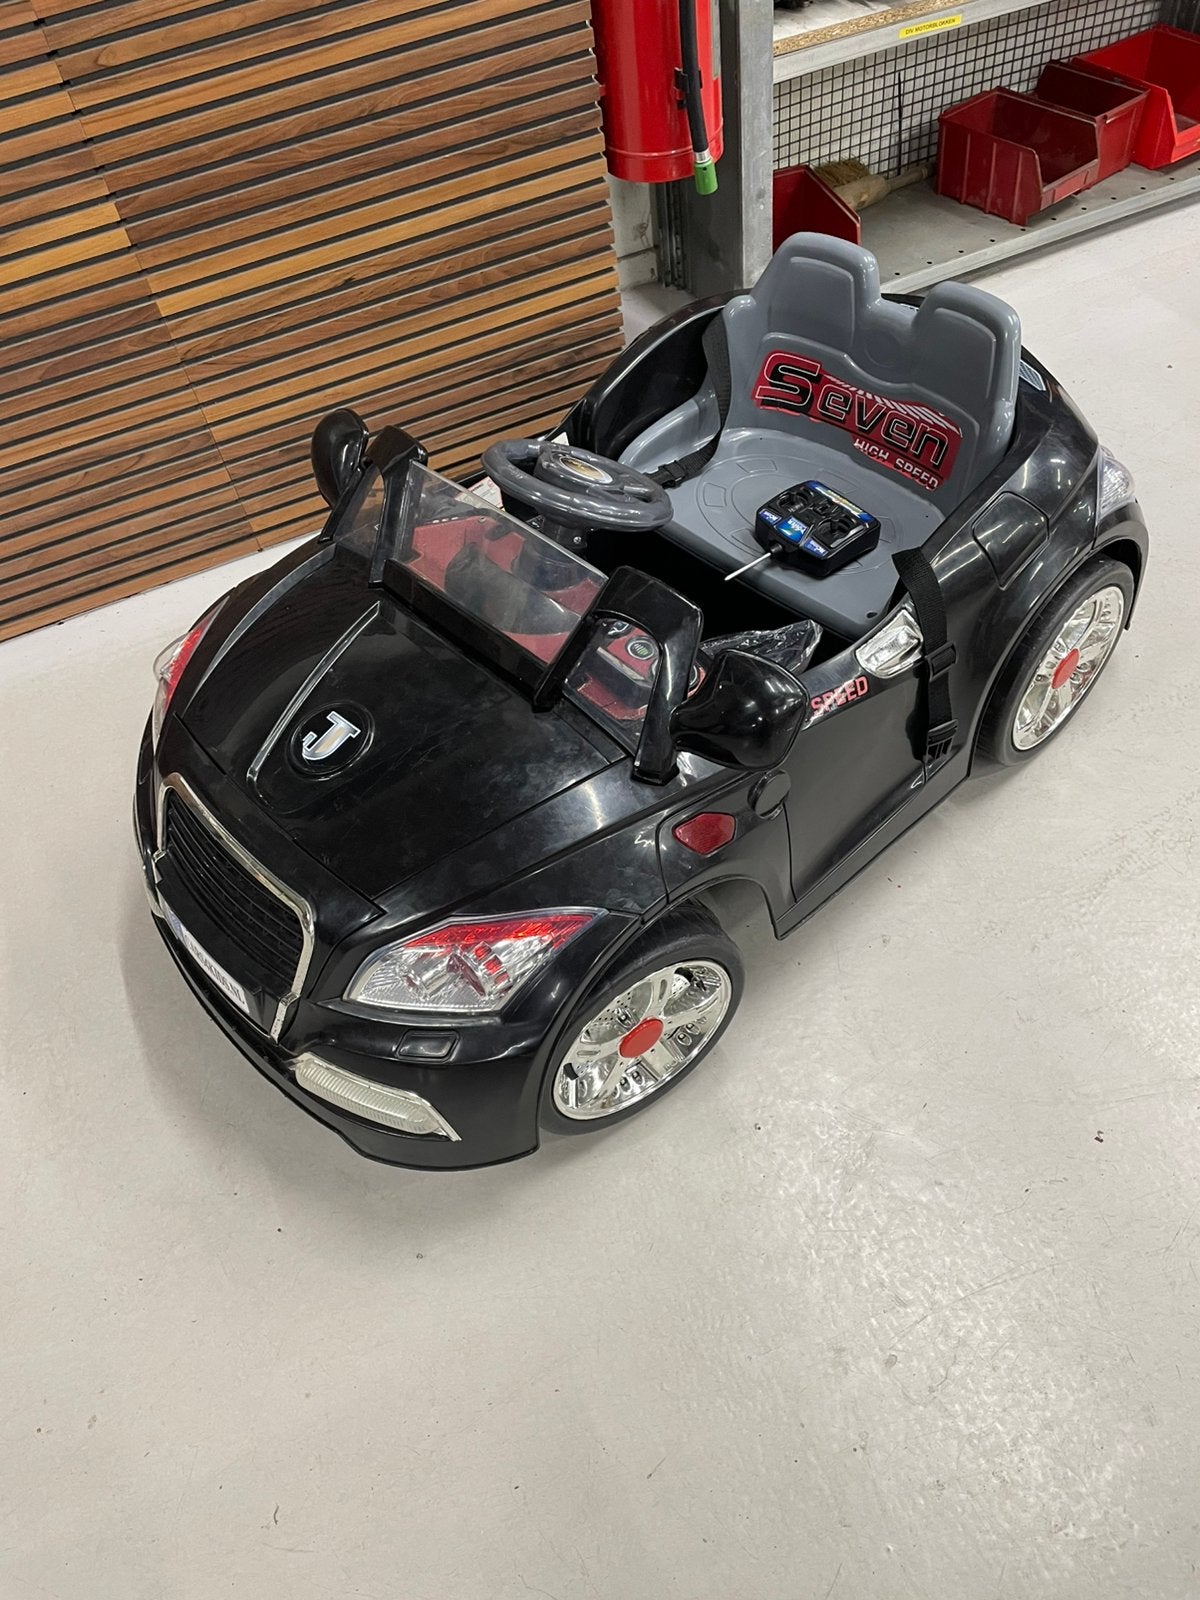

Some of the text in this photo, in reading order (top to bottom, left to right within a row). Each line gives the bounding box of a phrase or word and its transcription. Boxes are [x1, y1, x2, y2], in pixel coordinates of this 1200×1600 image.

[755, 352, 951, 467] Seven
[853, 438, 939, 491] HIGH SPEED
[810, 675, 869, 717] SPEED
[302, 711, 361, 760] J
